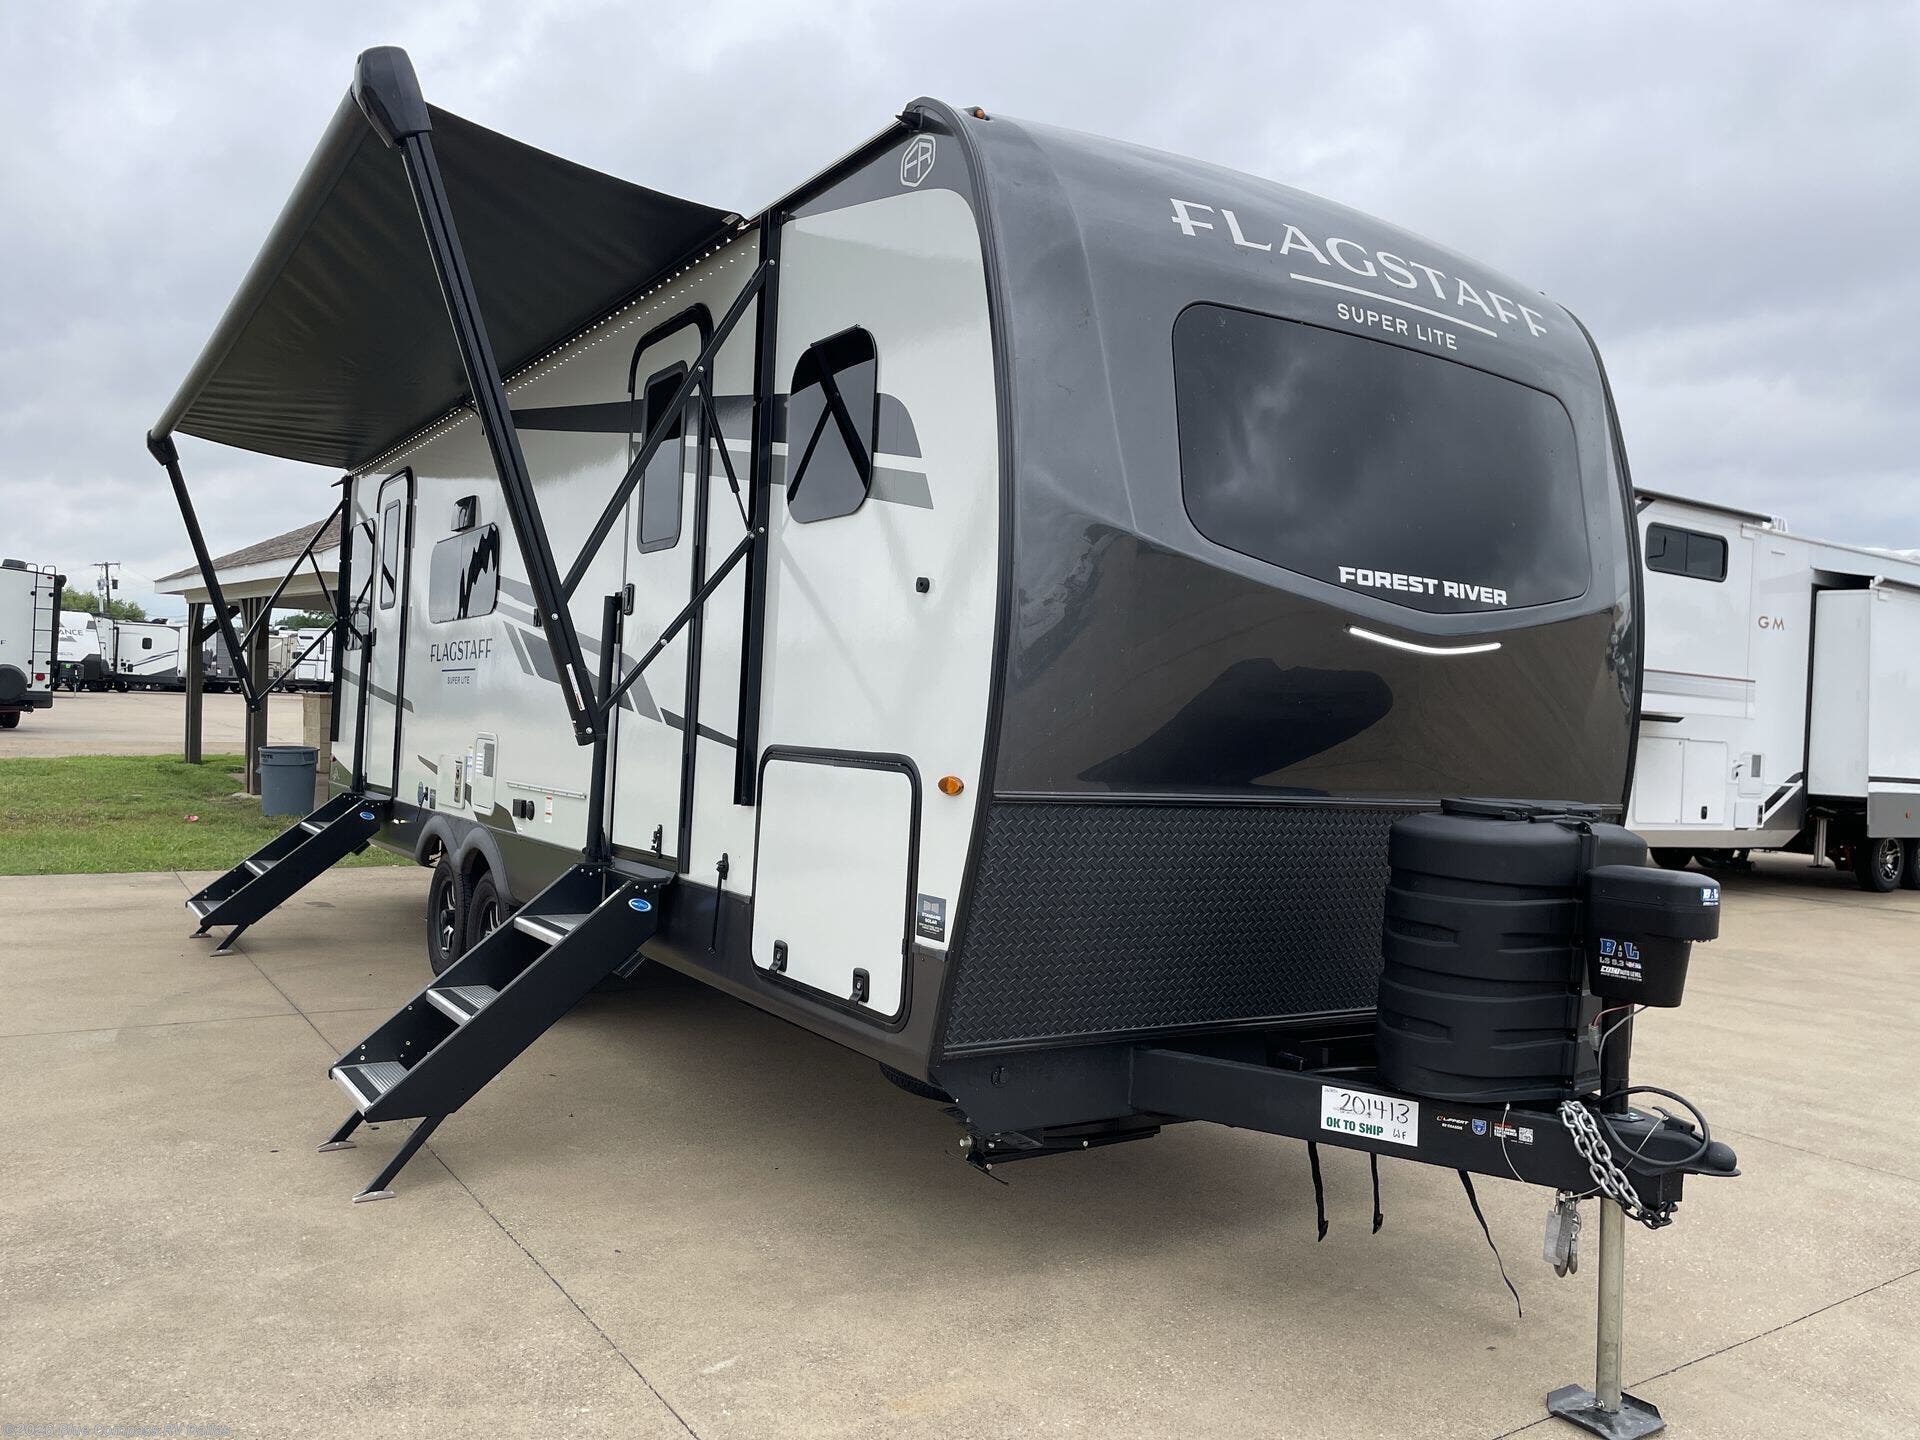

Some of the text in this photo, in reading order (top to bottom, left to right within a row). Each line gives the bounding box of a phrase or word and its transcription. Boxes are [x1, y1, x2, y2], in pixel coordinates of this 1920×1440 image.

[1169, 197, 1548, 338] FLAGSTAFF
[1336, 303, 1458, 351] SUPER LITE
[1338, 565, 1508, 606] FOREST RIVER
[430, 637, 493, 662] FLAGSTAFF
[1326, 1116, 1384, 1136] OK TO SHIP
[1339, 1093, 1410, 1124] 201413
